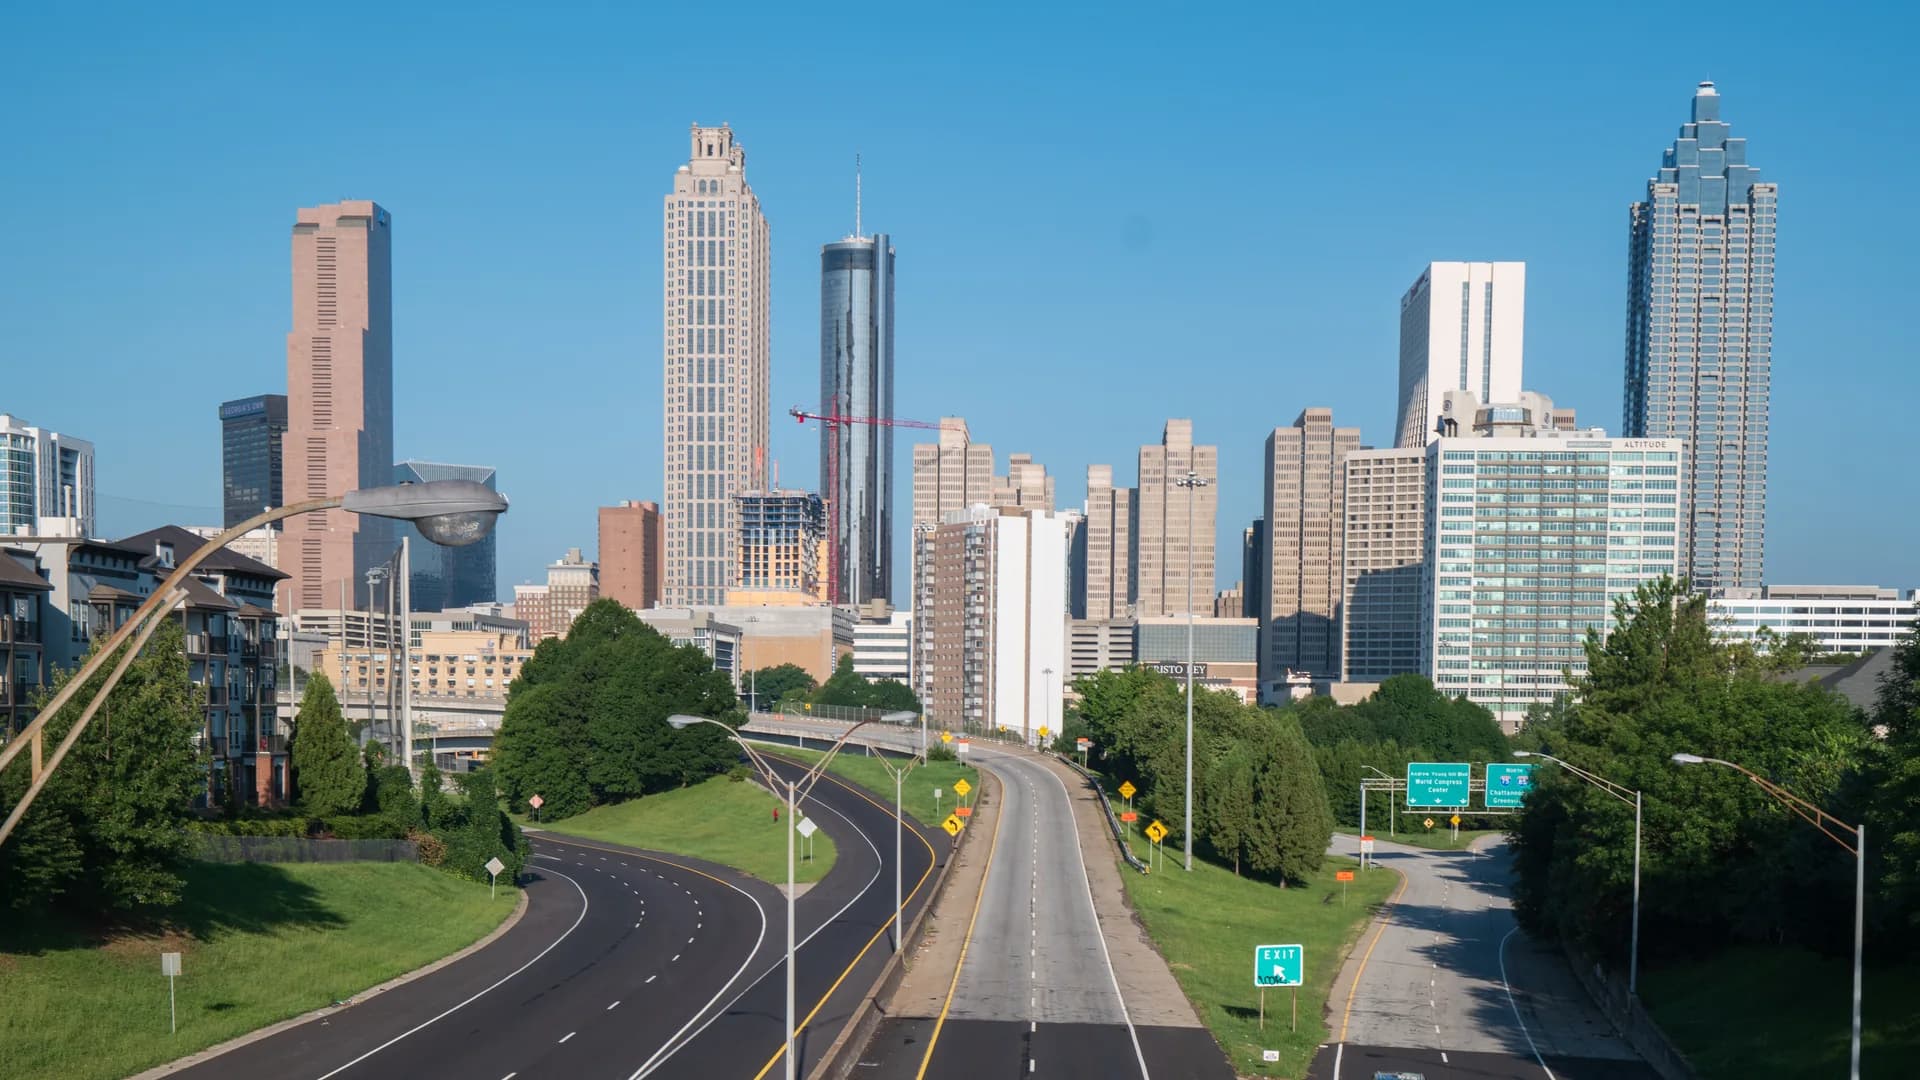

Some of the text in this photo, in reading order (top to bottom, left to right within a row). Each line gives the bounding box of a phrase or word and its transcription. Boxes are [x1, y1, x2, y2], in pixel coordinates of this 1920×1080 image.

[1624, 440, 1667, 448] ALTITUDE
[1434, 778, 1463, 786] Congress
[1263, 949, 1295, 960] EXIT
